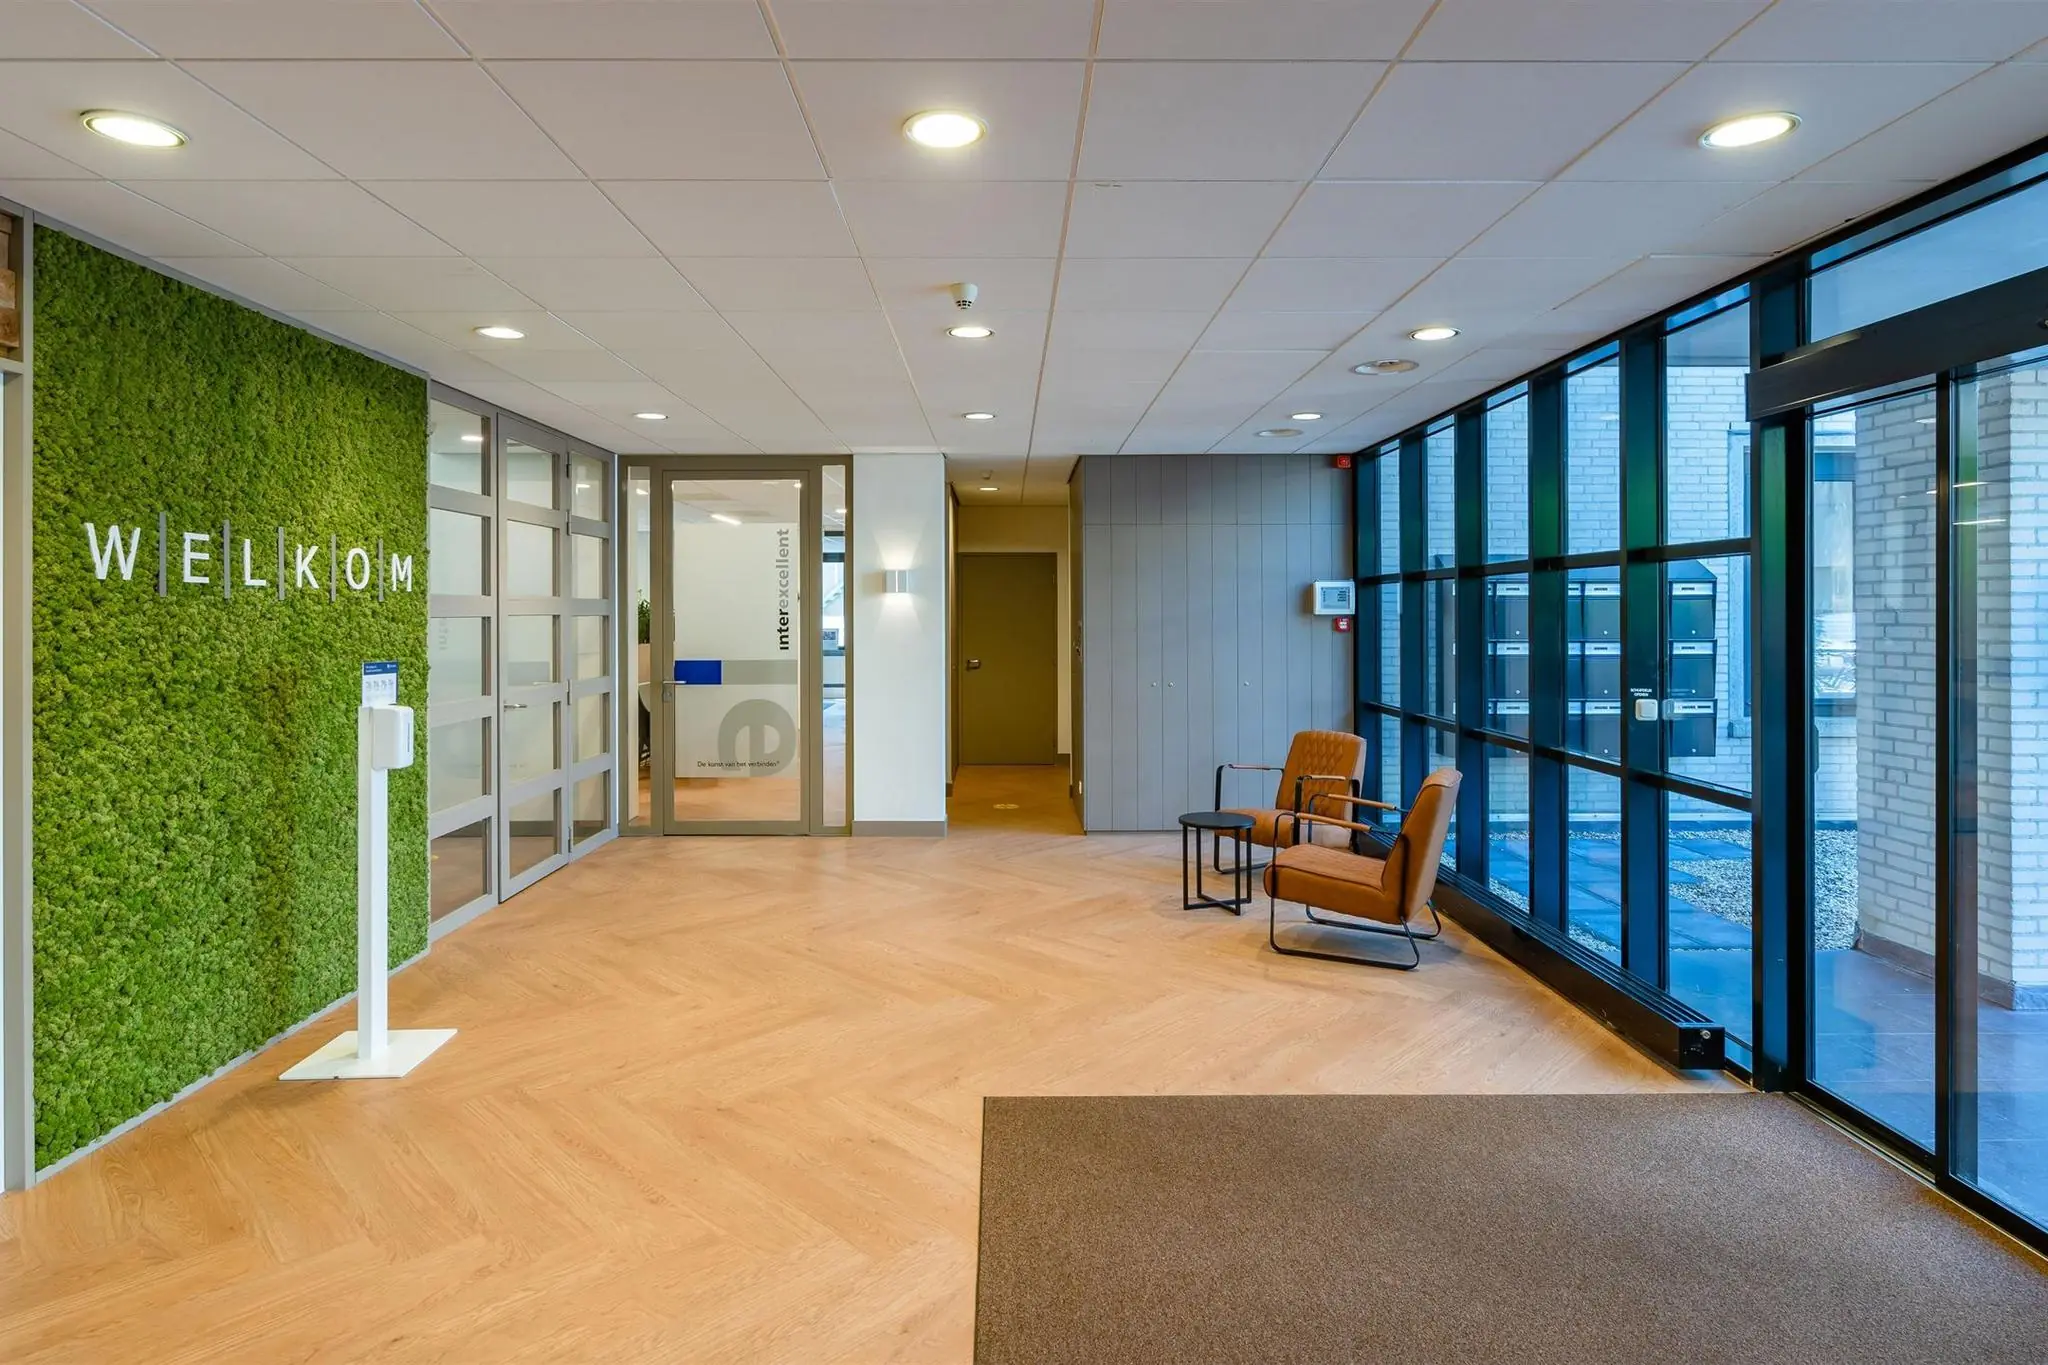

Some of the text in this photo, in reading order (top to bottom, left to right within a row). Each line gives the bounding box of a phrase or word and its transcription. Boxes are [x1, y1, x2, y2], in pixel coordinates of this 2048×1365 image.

[84, 522, 413, 592] WELKOM
[776, 528, 790, 650] interexcellent
[697, 760, 706, 768] De
[708, 760, 723, 768] kunst
[737, 760, 746, 768] het
